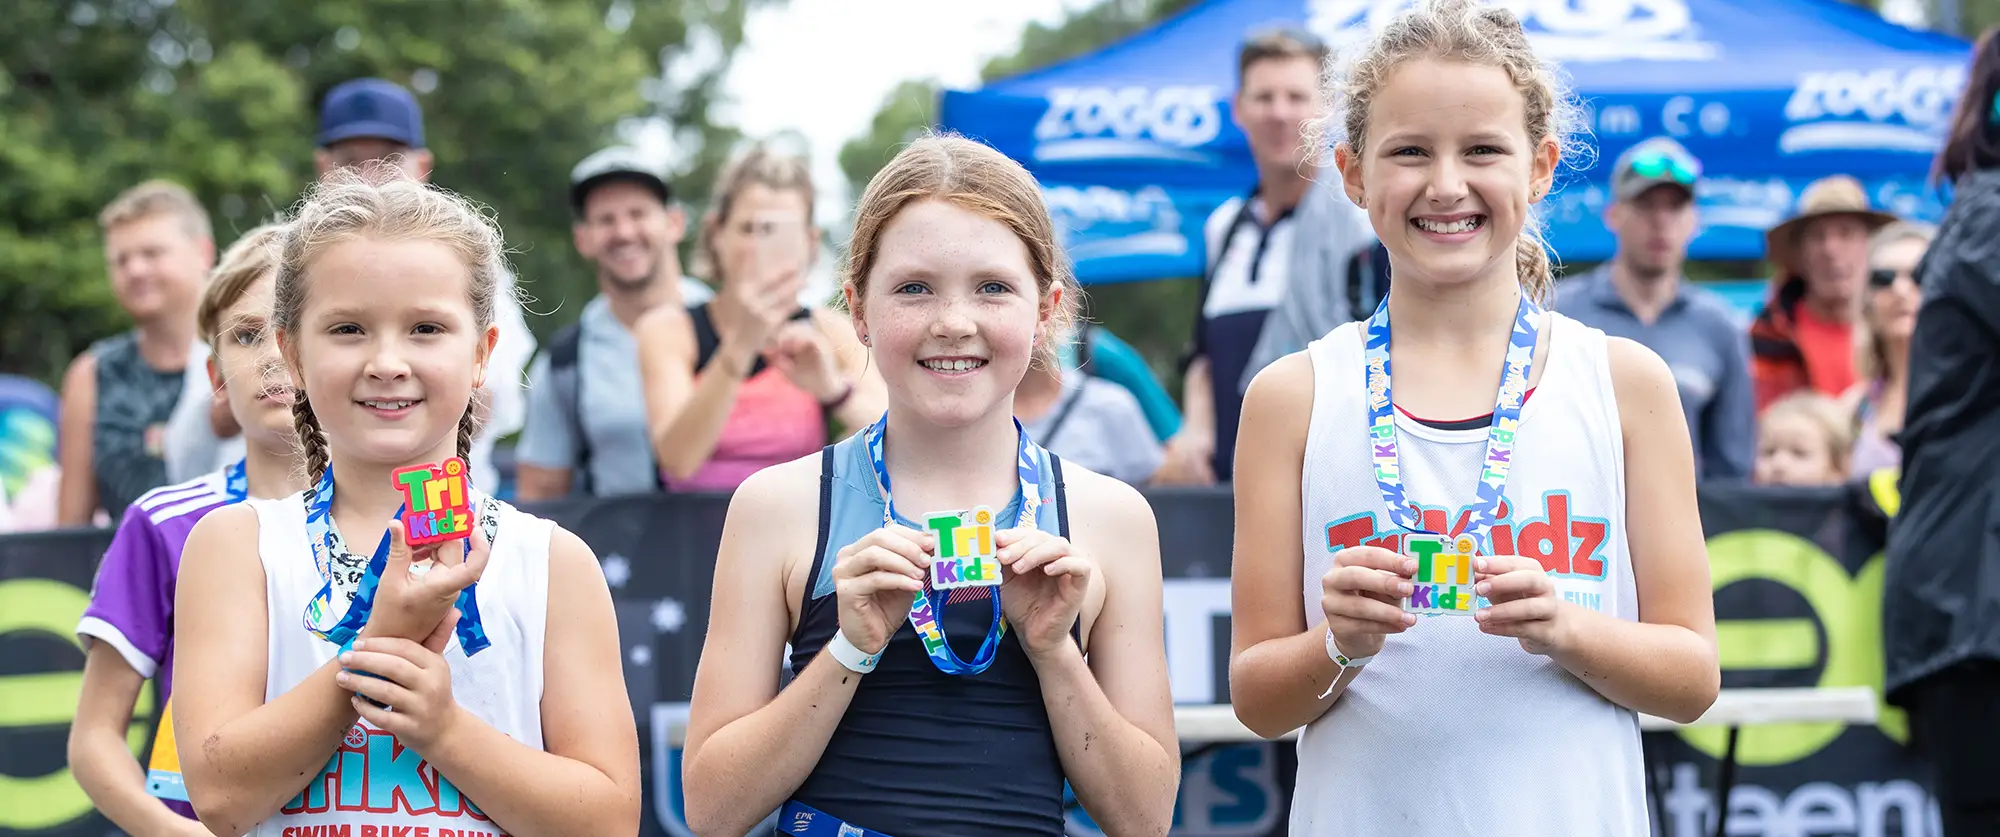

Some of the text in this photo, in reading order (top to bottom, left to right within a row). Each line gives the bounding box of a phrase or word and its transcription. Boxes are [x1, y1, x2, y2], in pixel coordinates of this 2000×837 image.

[398, 460, 463, 512] Tri
[408, 509, 468, 540] Kidz
[928, 509, 992, 558] Tri
[936, 557, 997, 585] Kidz
[1410, 538, 1473, 585] Tri
[1411, 585, 1471, 611] Kidz
[794, 811, 816, 821] EPIC
